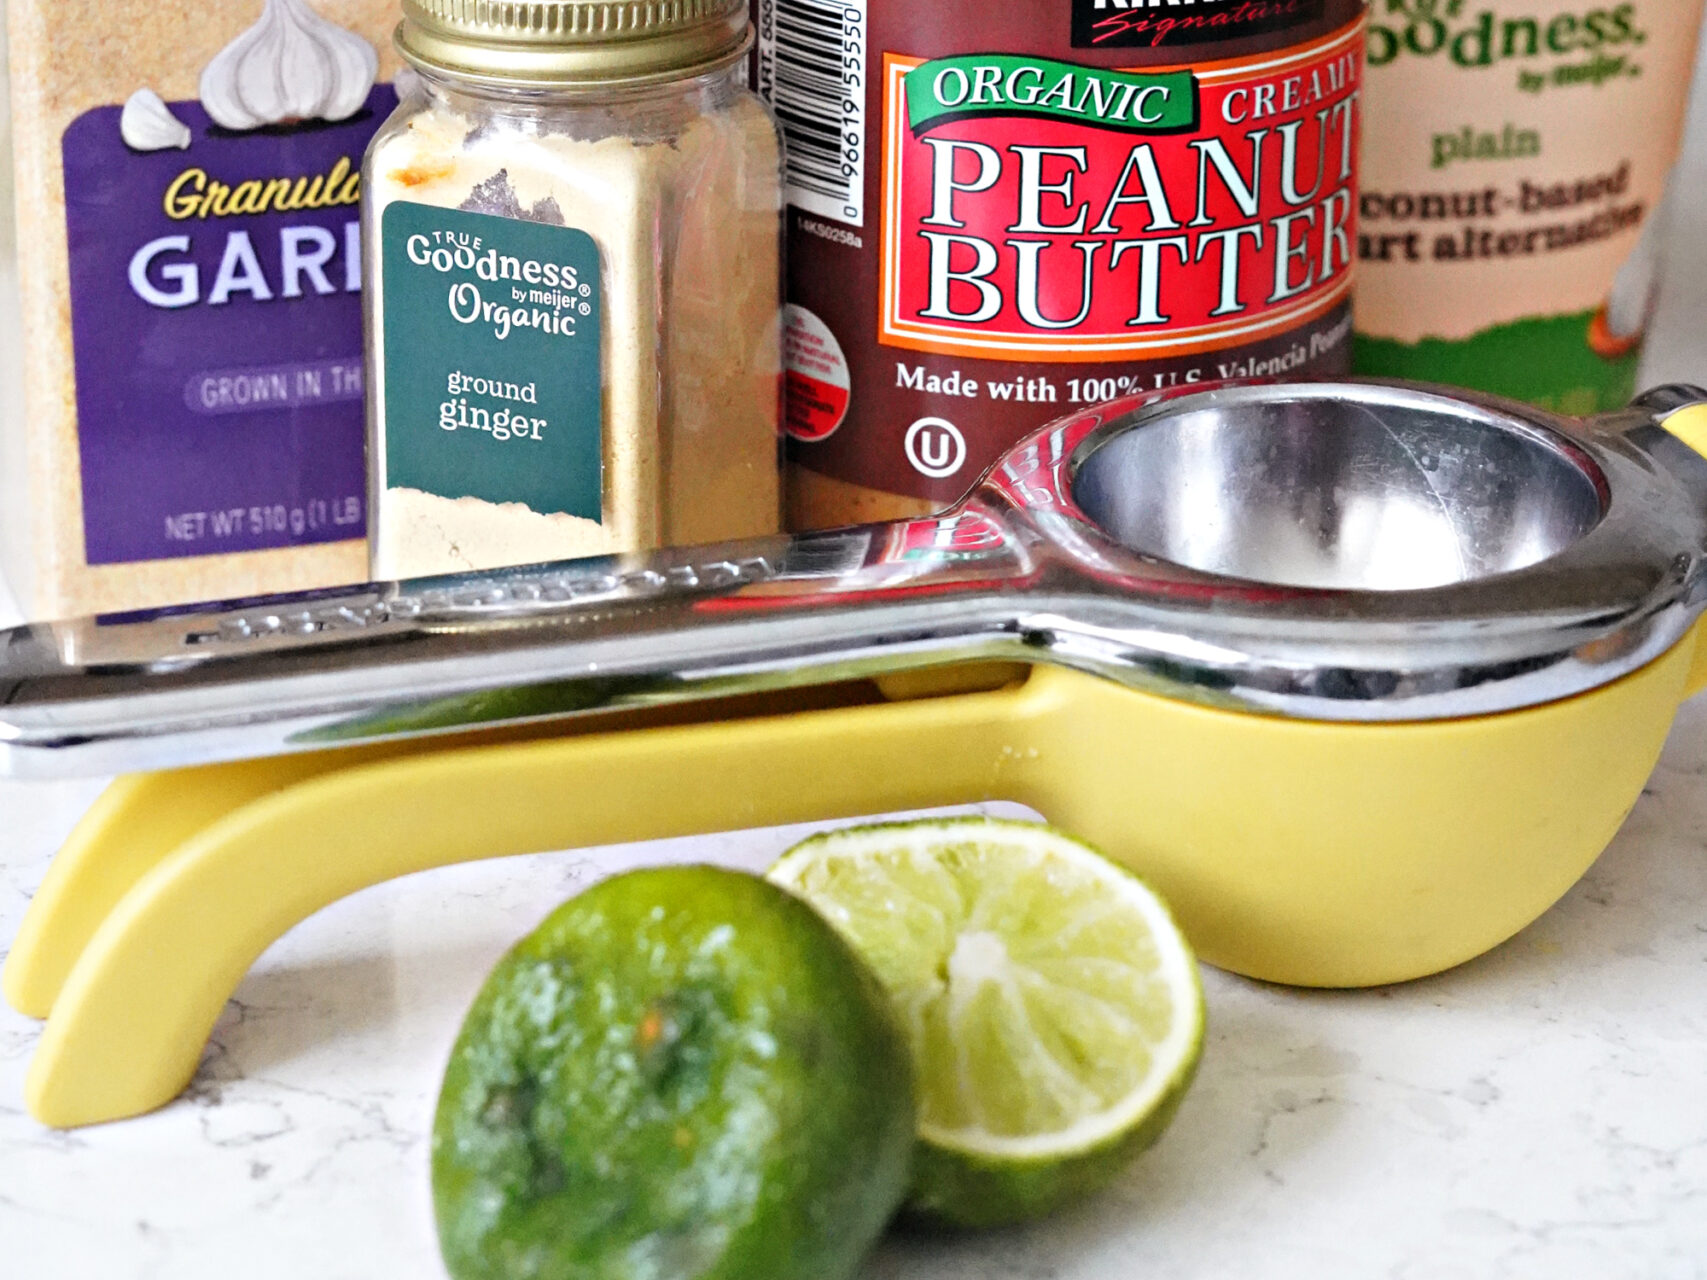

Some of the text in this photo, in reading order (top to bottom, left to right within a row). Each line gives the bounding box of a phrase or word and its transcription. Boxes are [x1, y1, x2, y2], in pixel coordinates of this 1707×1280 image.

[843, 7, 863, 87] 55550
[931, 66, 1170, 124] ORGANIC
[841, 97, 860, 177] 96619
[1430, 123, 1542, 169] plain
[919, 89, 1361, 235] PEANUT
[843, 205, 858, 218] 0
[432, 230, 482, 251] TRUE
[917, 185, 1354, 331] BUTTER
[448, 282, 577, 340] Organic
[511, 285, 527, 303] by
[200, 374, 288, 409] GROWN
[296, 371, 321, 399] IN
[447, 370, 538, 405] ground
[895, 363, 979, 397] Made
[988, 380, 1057, 403] with
[1066, 374, 1144, 404] 100%
[439, 398, 548, 441] ginger
[163, 512, 205, 541] NET
[212, 510, 246, 537] WT
[333, 494, 361, 525] LB
